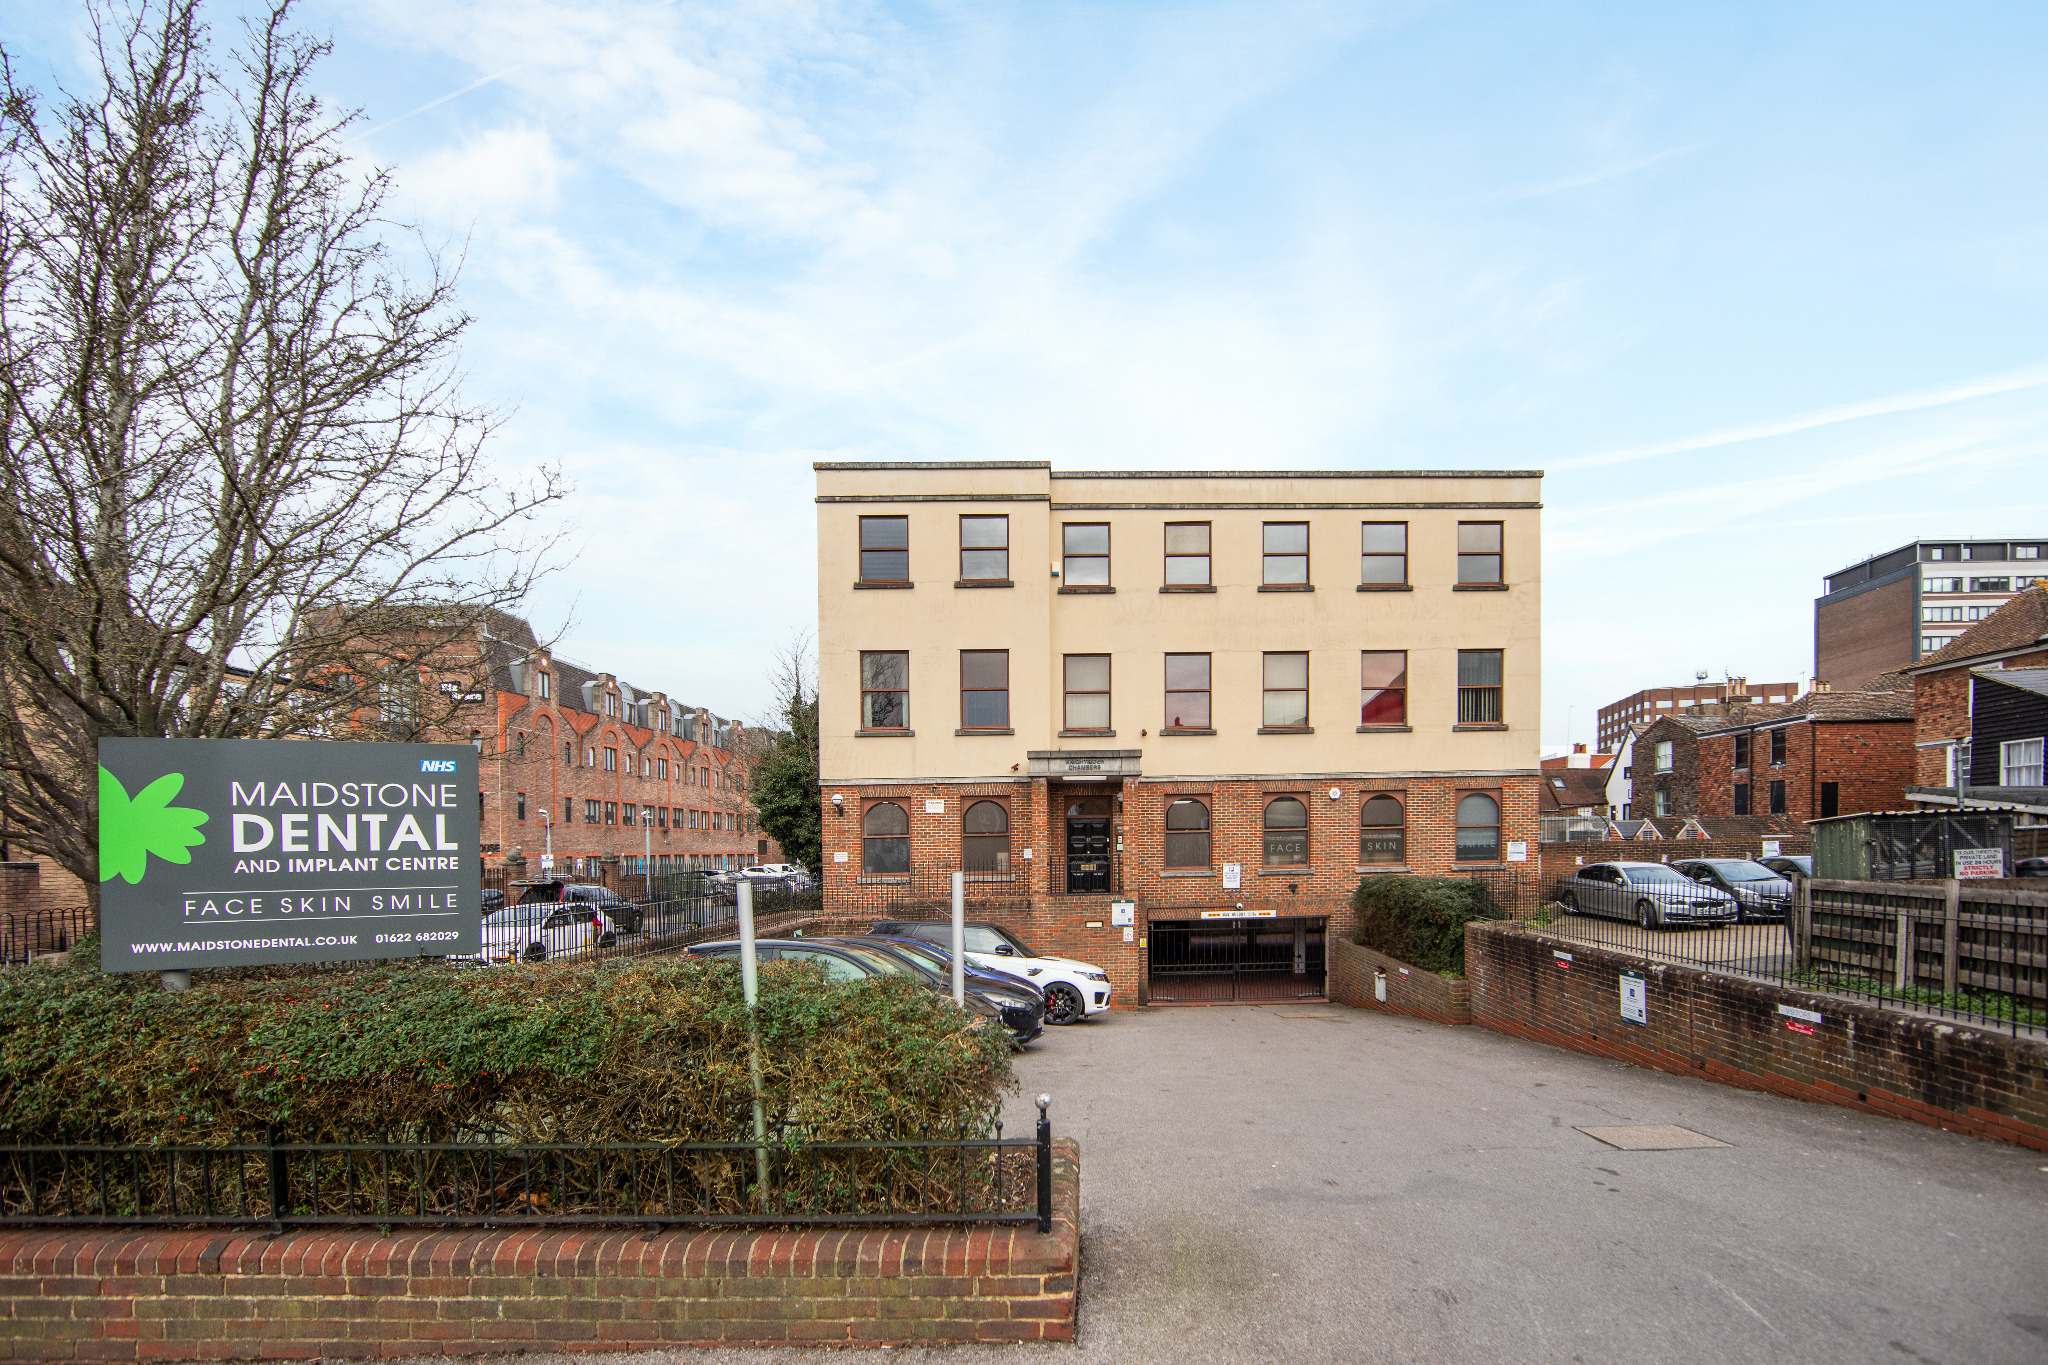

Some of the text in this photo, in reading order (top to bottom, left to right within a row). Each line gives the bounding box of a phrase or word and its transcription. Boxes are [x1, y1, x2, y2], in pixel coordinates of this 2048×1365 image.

[421, 760, 456, 772] NHS
[231, 781, 458, 808] MAIDSTONE
[232, 813, 459, 853] DENTAL
[1270, 843, 1301, 852] FACE
[1367, 841, 1396, 850] SKIN
[233, 856, 459, 874] AND IMPLANT CENTRE
[184, 893, 458, 916] FACE SKIN SMILE
[131, 931, 460, 954] WWW.MAIDSTONEDENTAL.CO.UK 01622 682029
